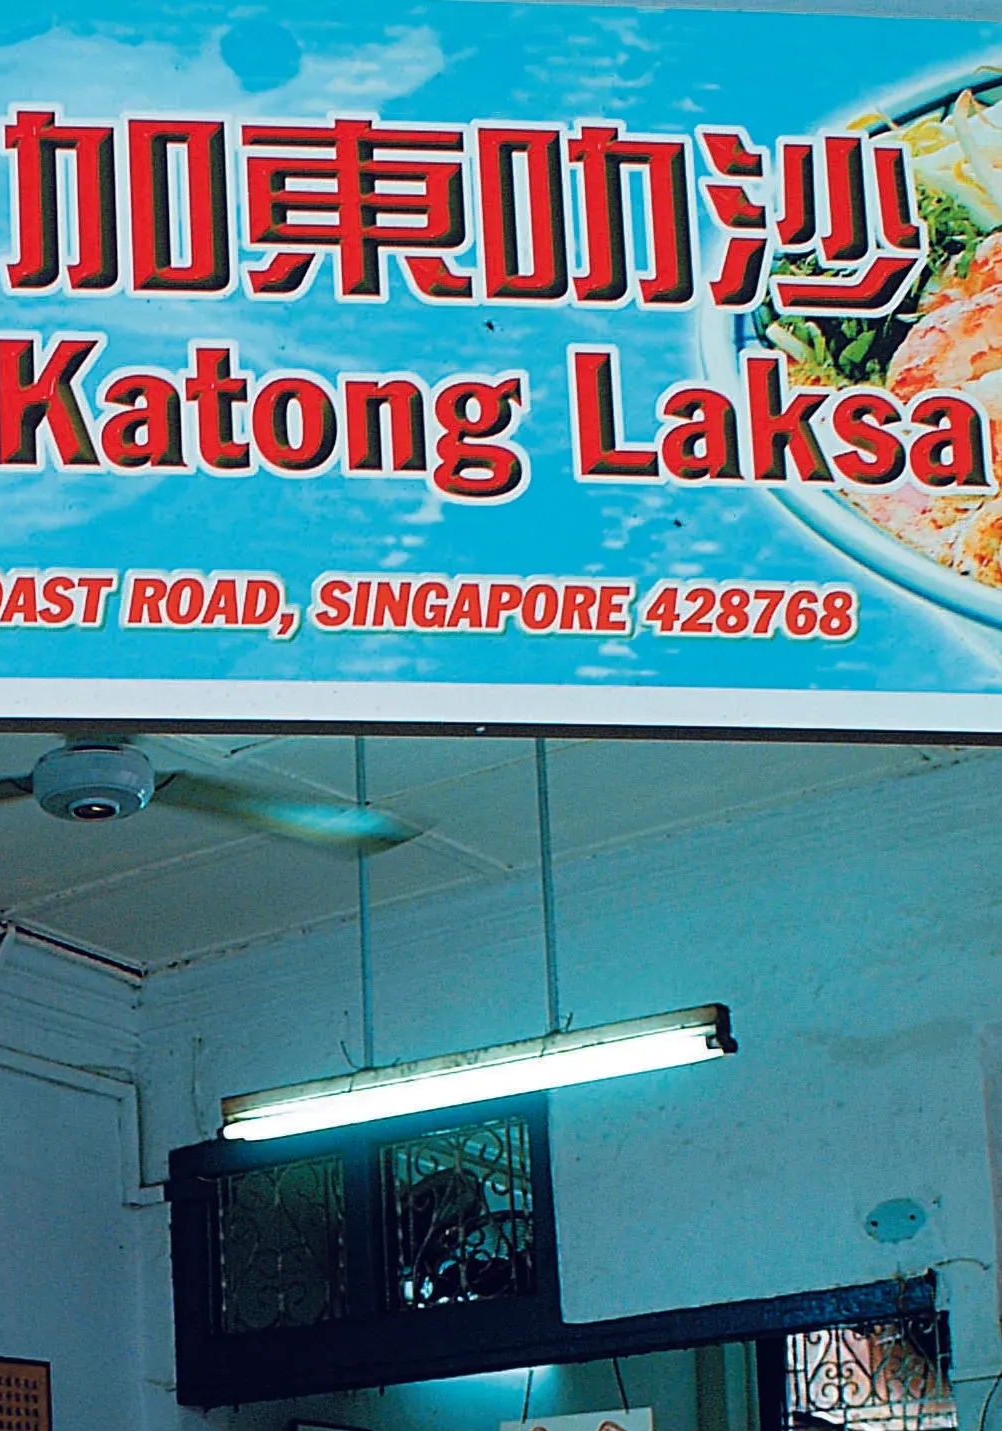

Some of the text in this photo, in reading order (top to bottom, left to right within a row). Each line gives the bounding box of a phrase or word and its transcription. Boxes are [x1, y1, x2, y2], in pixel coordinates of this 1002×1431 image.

[3, 110, 922, 312] 加東叻沙
[572, 351, 991, 488] Laksa
[127, 575, 295, 636] ROAD,
[314, 579, 632, 634] SINGAPORE
[645, 585, 853, 636] 428768
